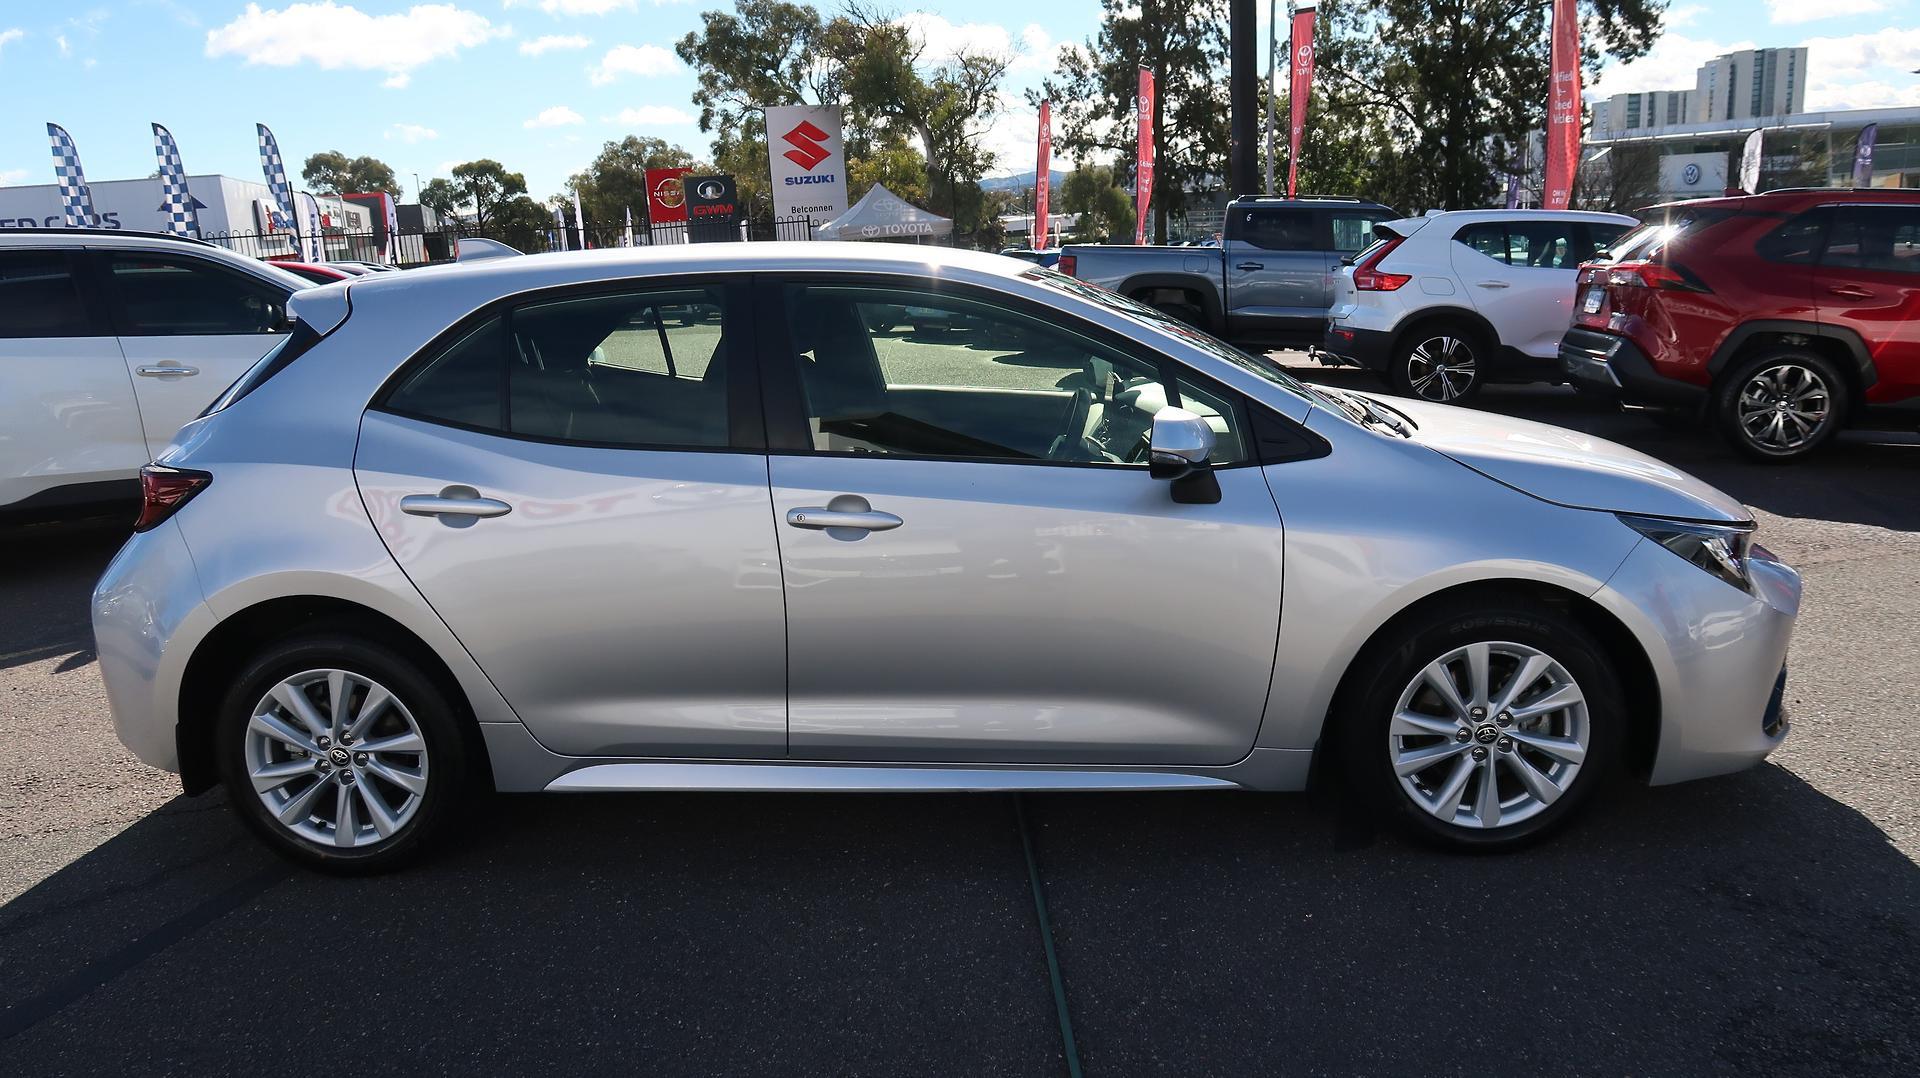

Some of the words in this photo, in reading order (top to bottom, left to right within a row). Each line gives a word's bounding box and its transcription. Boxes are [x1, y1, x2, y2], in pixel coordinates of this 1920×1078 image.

[785, 174, 835, 186] SUZUKI
[693, 204, 734, 216] GWM
[791, 205, 833, 214] Belconnen
[1246, 213, 1252, 222] 6
[884, 223, 933, 235] TOYOTA
